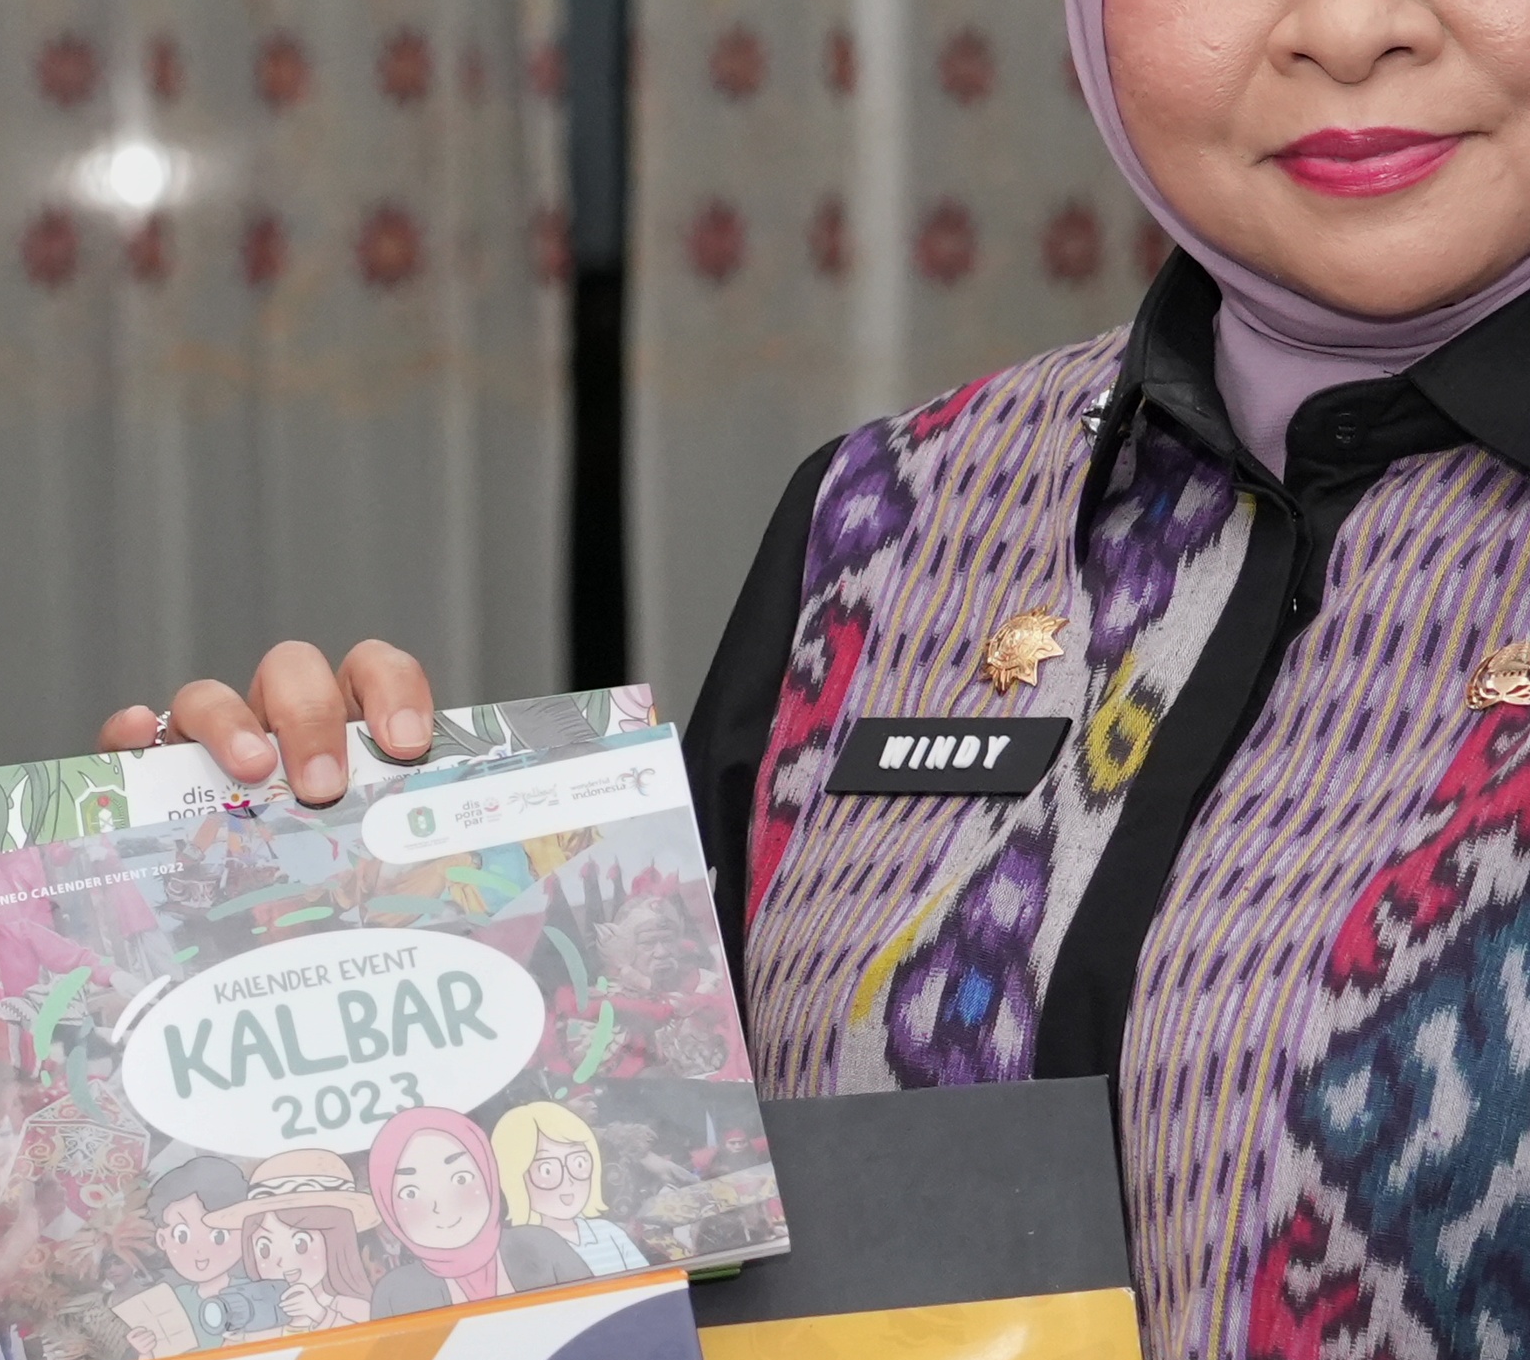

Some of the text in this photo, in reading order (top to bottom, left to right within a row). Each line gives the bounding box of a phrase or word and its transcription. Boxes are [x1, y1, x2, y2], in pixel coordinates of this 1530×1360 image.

[878, 734, 1012, 770] WINDY
[182, 785, 216, 806] dis
[30, 877, 102, 899] CALENDER
[105, 867, 148, 886] EVENT
[151, 861, 185, 877] 2022
[213, 946, 419, 1005] KALENDER EVENT
[163, 970, 498, 1100] KALBAR
[271, 1071, 425, 1140] 2023
